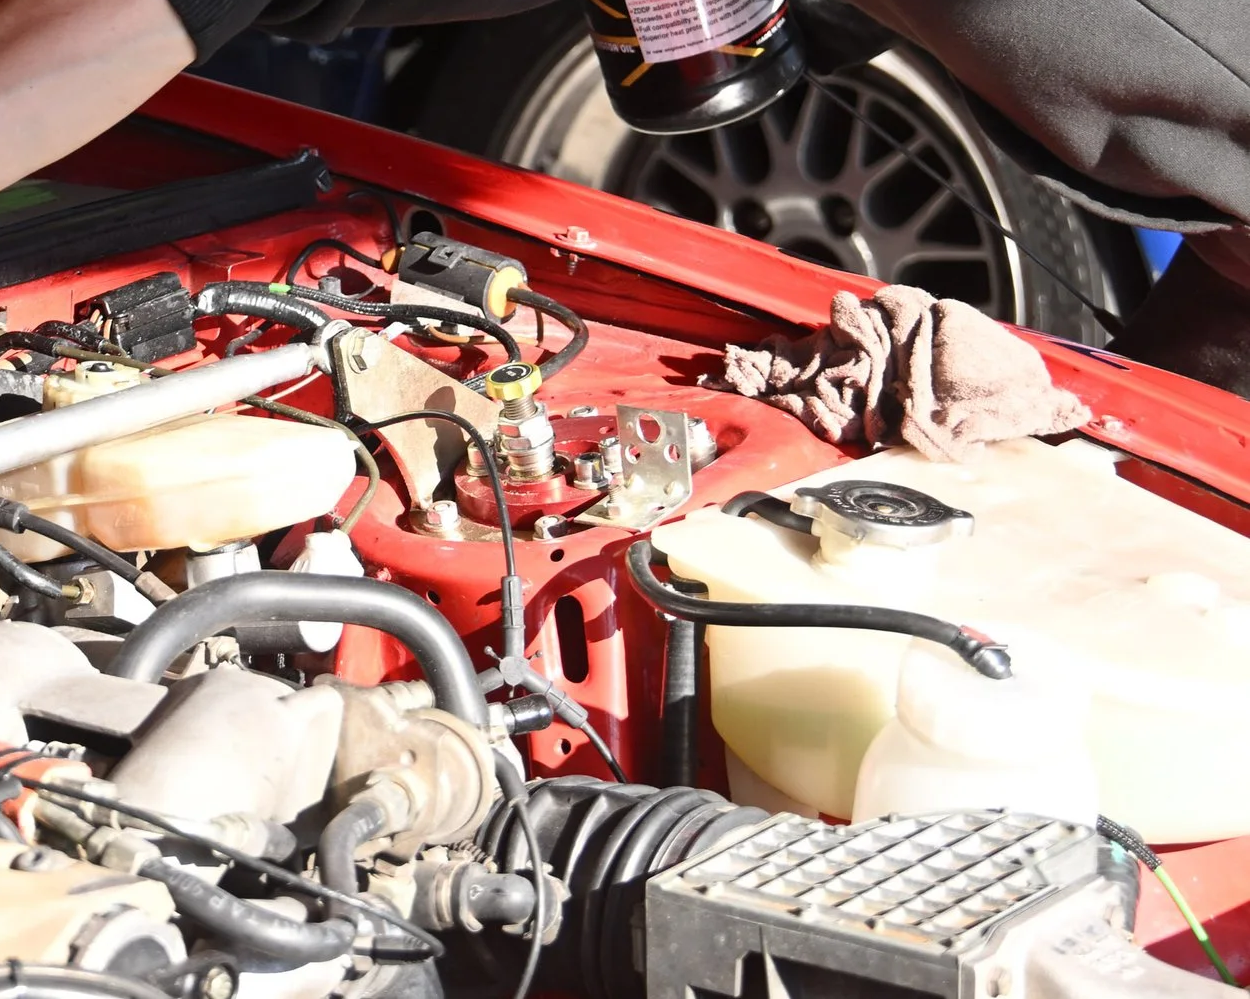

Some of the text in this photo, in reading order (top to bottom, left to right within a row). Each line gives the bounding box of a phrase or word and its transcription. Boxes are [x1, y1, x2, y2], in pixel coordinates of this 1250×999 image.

[634, 7, 651, 15] ZDDP
[652, 1, 678, 11] additive
[637, 14, 663, 23] Exceeds
[639, 25, 651, 33] Full
[642, 32, 669, 42] Superior
[670, 28, 685, 37] heat
[620, 44, 636, 53] OIL
